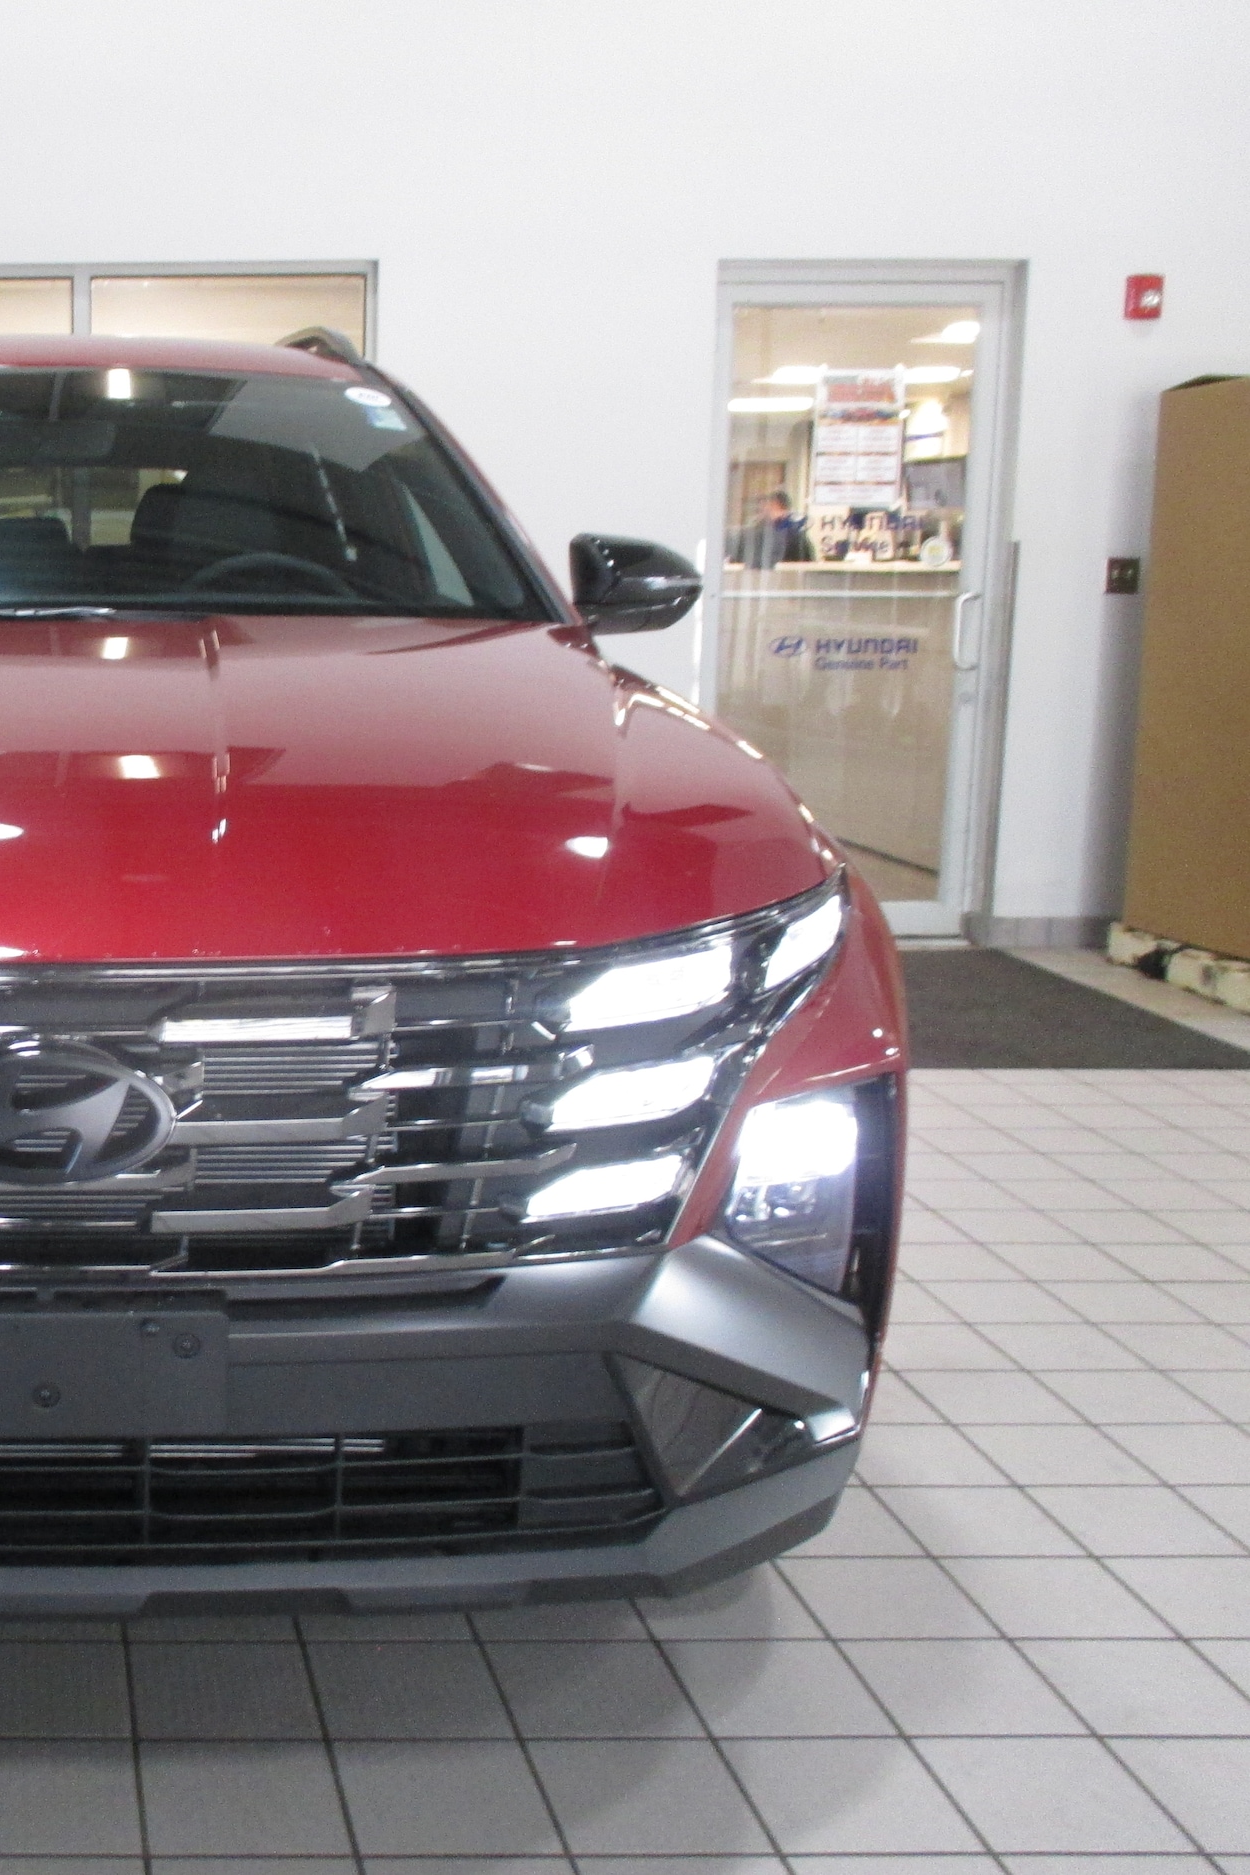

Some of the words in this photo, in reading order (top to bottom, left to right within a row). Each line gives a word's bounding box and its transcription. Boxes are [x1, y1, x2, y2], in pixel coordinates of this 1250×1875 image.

[820, 514, 924, 531] HYNDAI
[820, 536, 889, 554] Svice
[816, 637, 919, 654] HYUNDAI
